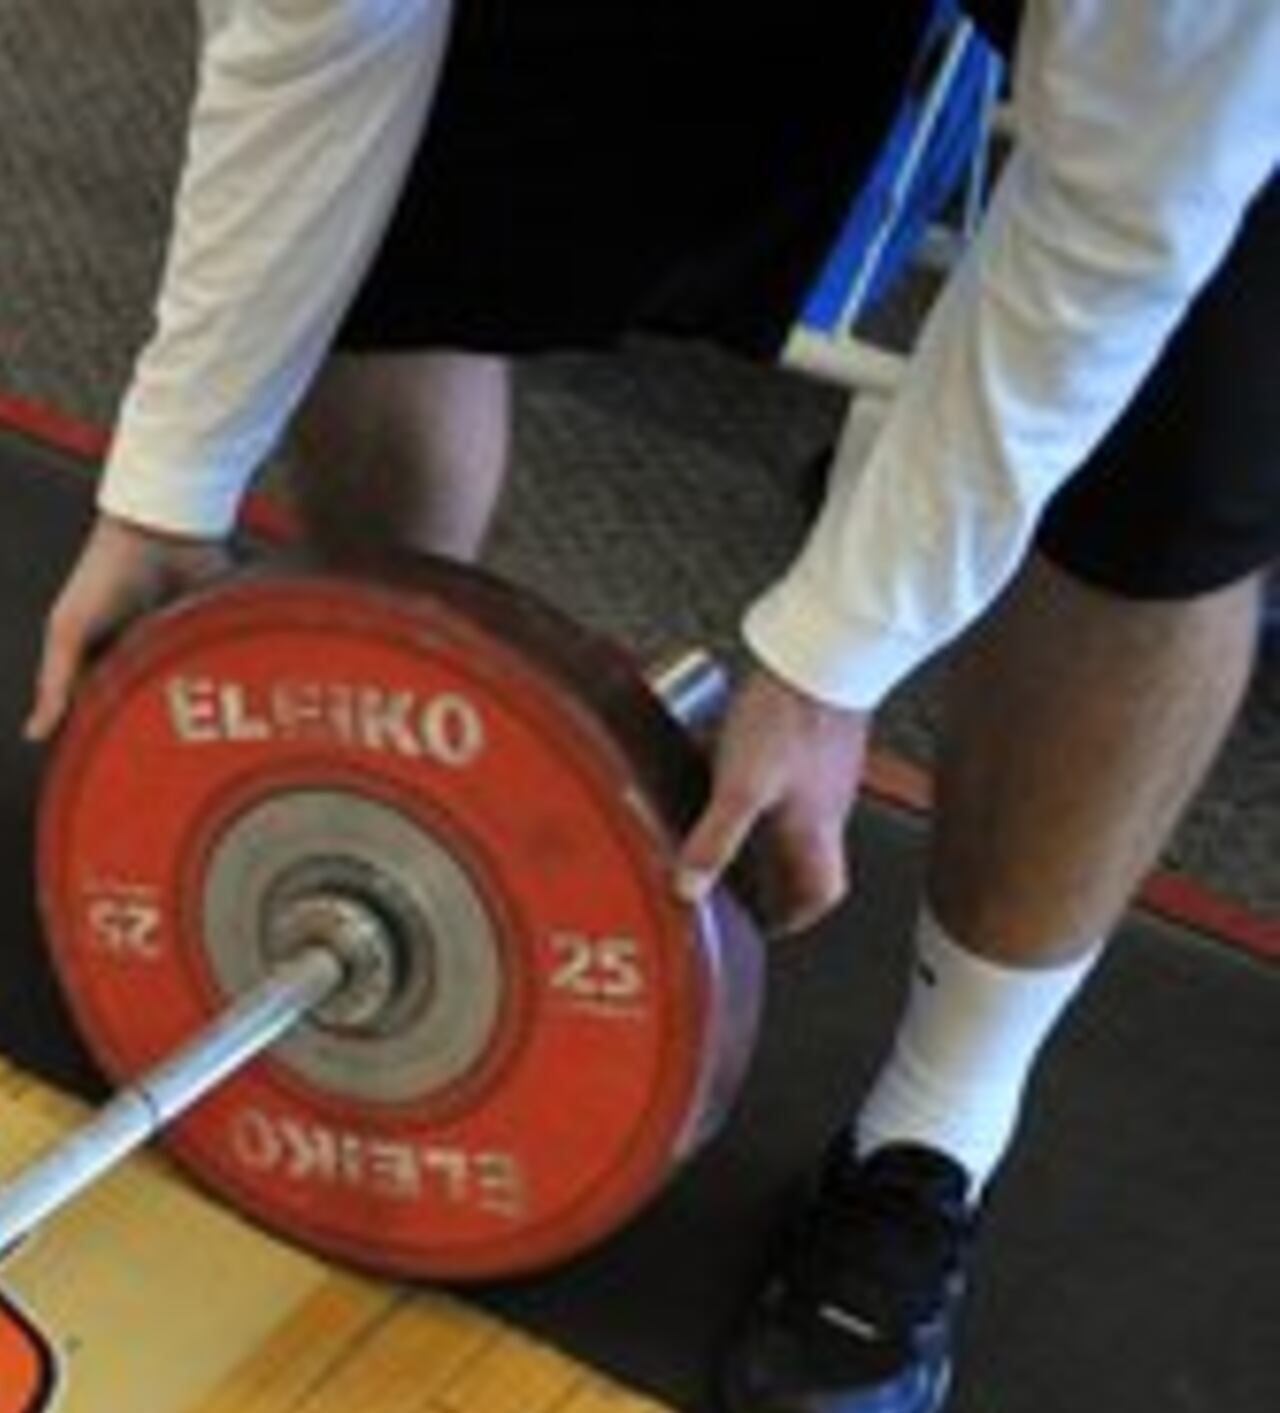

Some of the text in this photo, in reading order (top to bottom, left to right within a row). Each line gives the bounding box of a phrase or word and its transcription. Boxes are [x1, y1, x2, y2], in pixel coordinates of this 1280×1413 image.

[166, 674, 486, 770] ELEIKO
[546, 932, 644, 998] 25
[238, 1108, 530, 1222] ELEIKO
